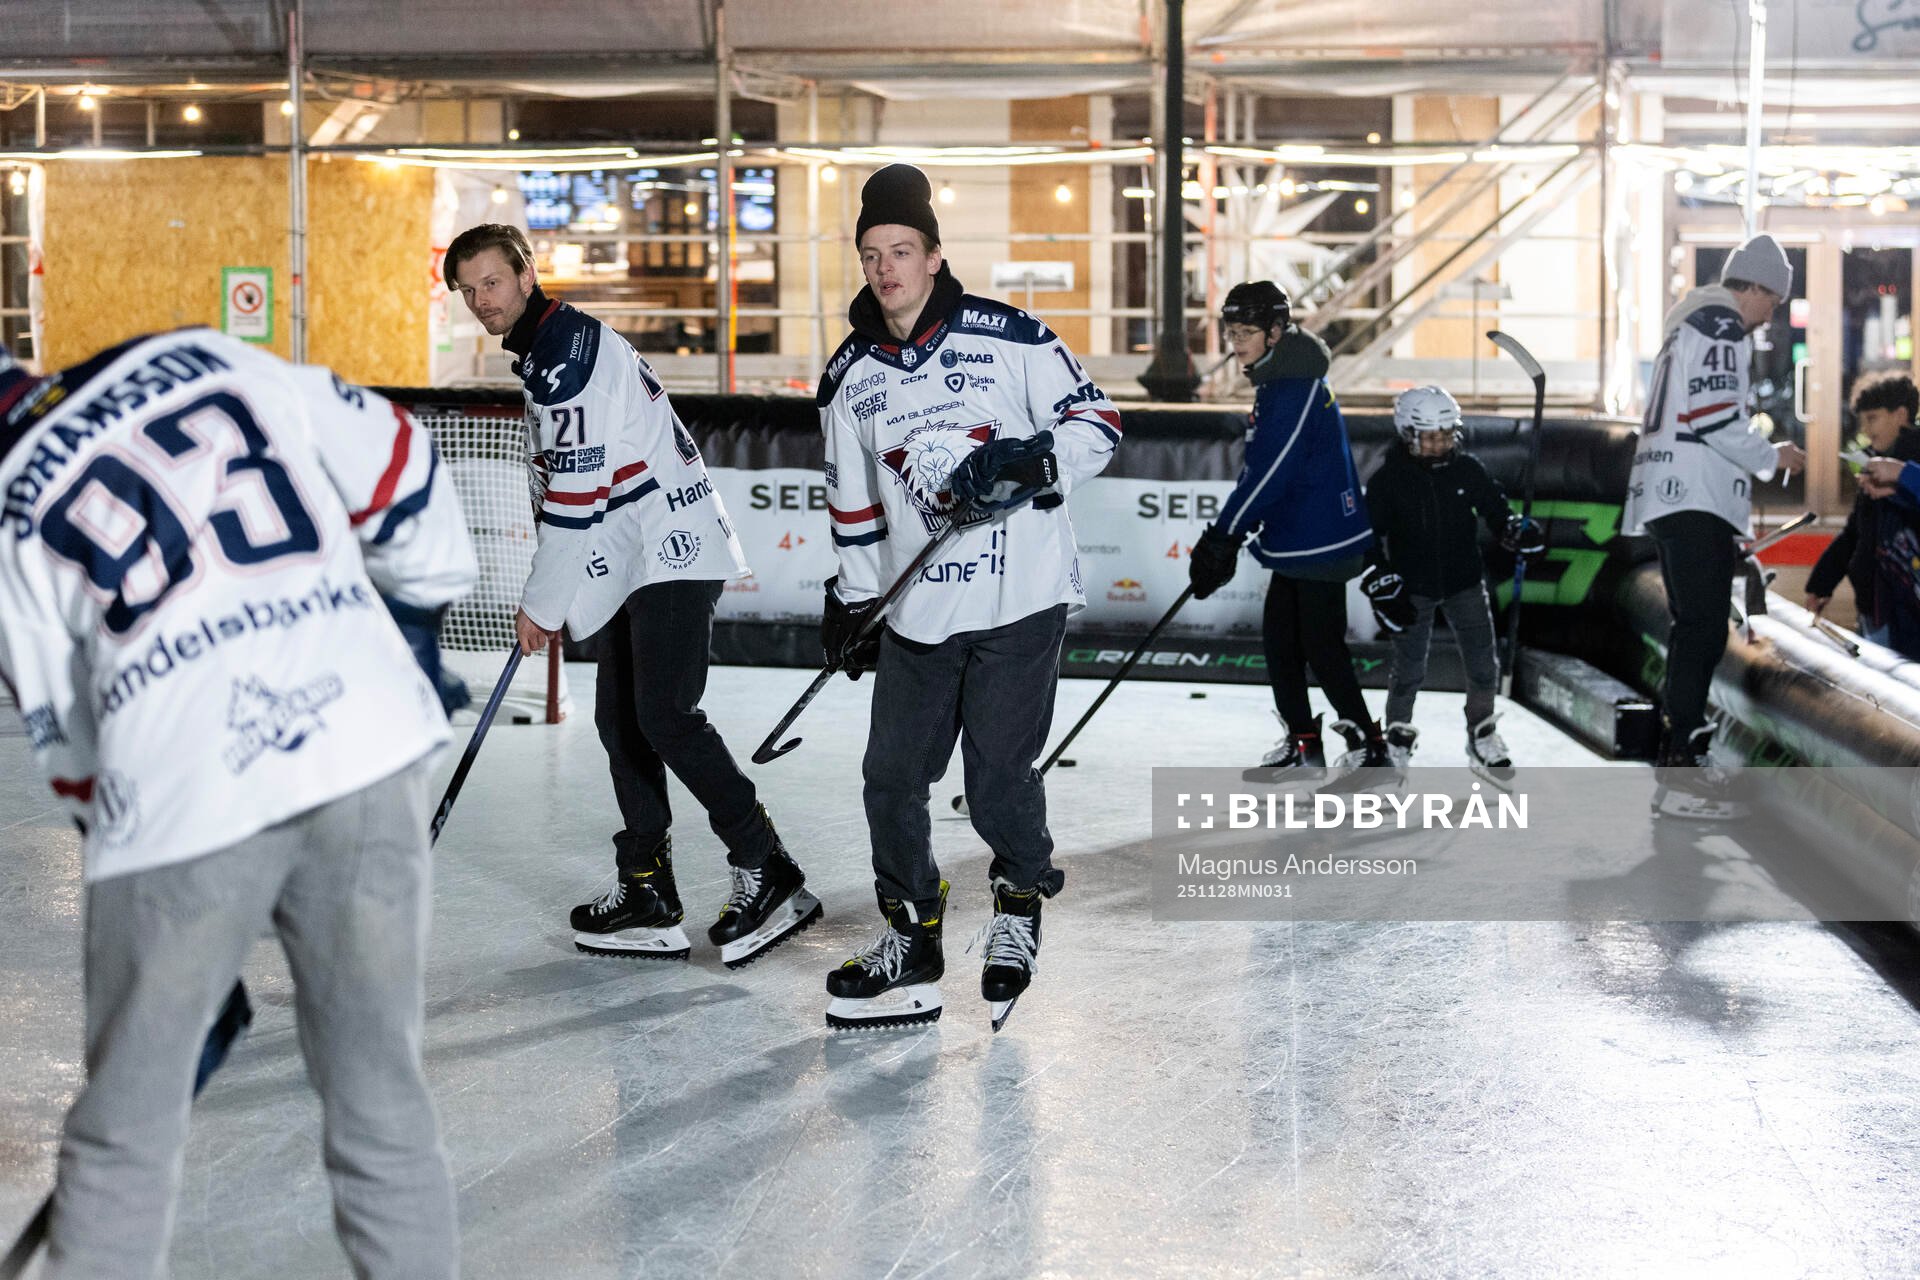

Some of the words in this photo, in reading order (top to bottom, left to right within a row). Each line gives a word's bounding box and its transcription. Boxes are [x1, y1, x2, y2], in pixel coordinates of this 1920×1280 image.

[962, 309, 1007, 328] MAXI
[569, 332, 581, 359] TOYOTA
[957, 352, 994, 364] SAAB
[1702, 345, 1738, 373] 40
[827, 343, 856, 382] MAXI
[900, 373, 928, 385] CCM
[851, 390, 888, 418] HOCKEY
[550, 406, 585, 447] 21
[38, 390, 323, 635] 93
